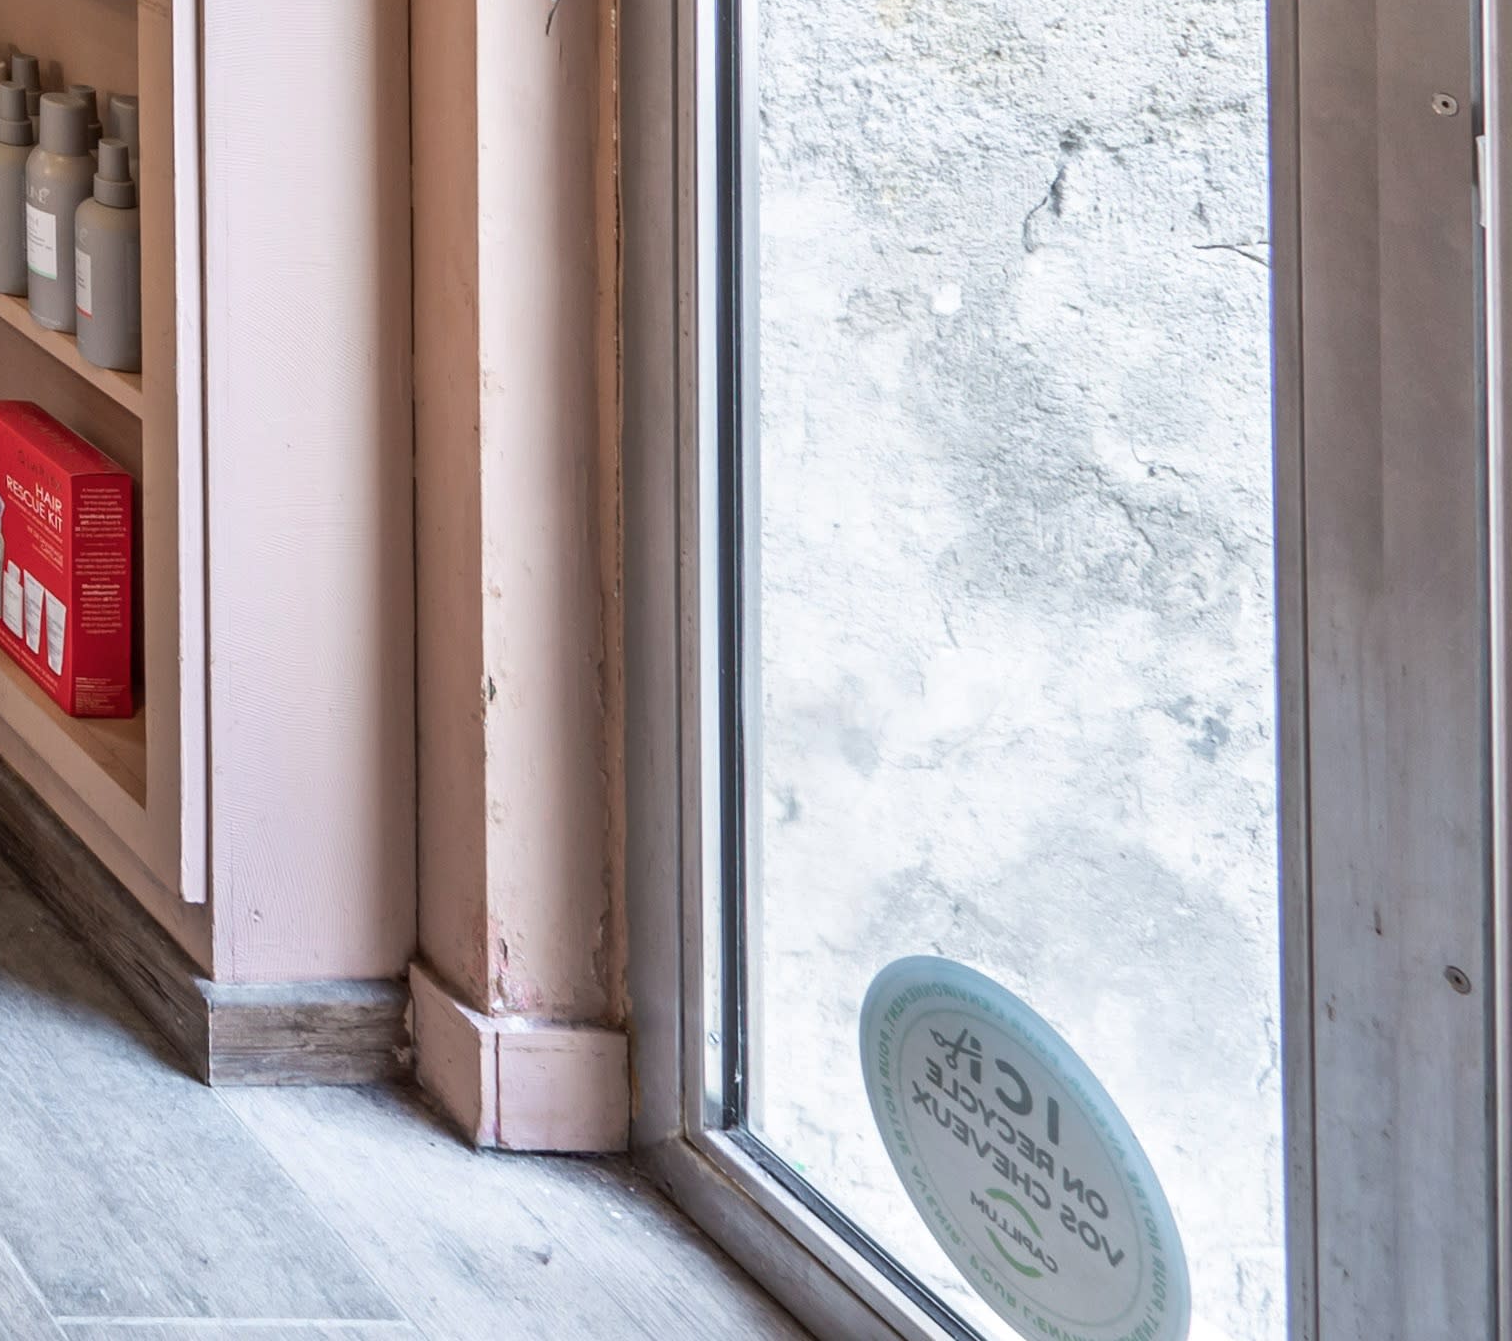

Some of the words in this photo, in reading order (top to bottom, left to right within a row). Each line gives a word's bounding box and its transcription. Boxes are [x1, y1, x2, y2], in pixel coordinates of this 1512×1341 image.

[5, 474, 47, 521] RESCUE
[48, 508, 64, 534] KIT
[35, 481, 63, 516] HAIR
